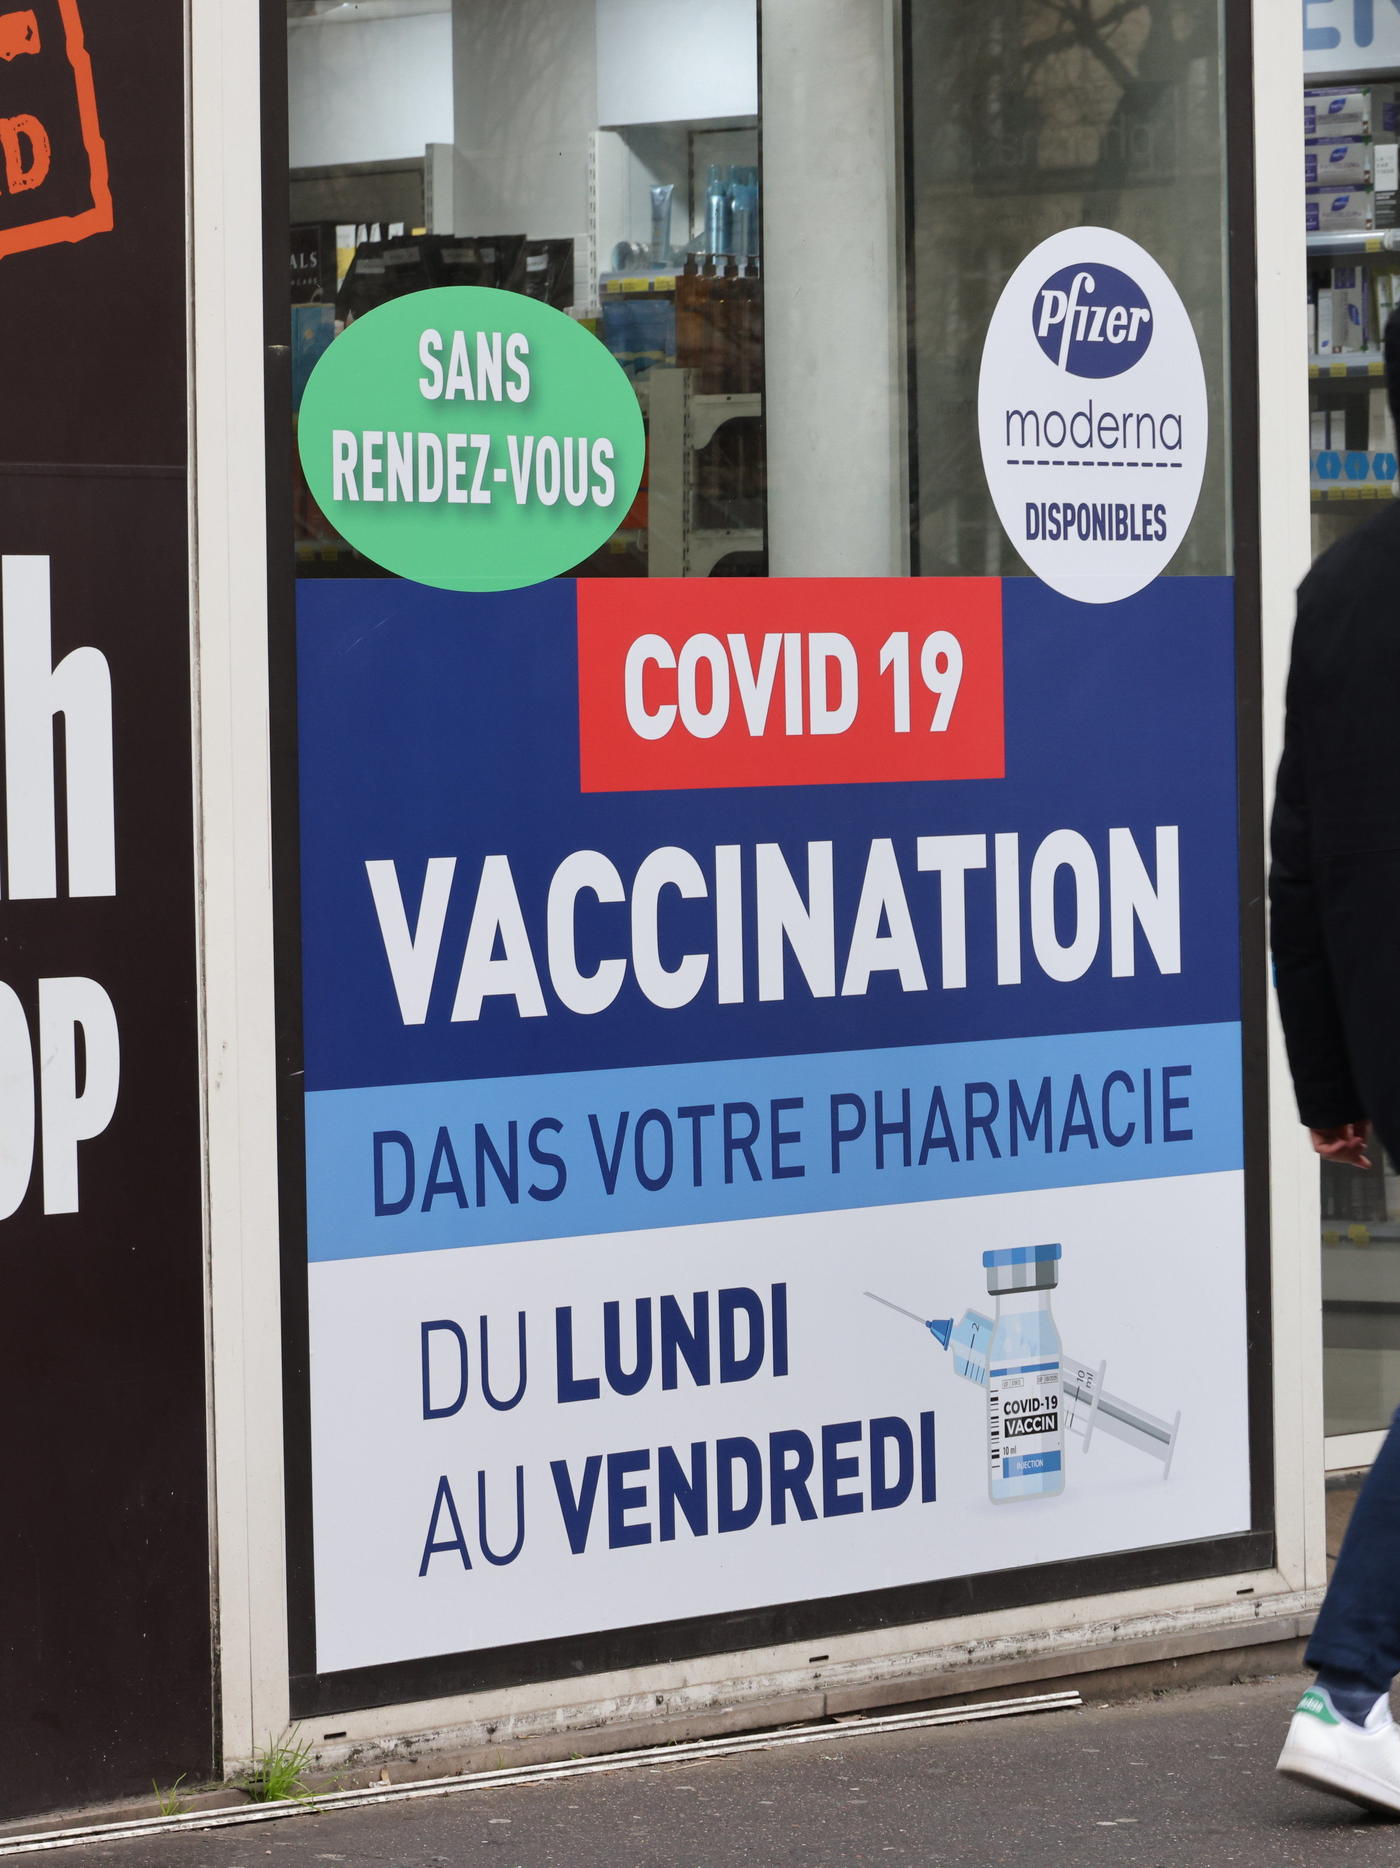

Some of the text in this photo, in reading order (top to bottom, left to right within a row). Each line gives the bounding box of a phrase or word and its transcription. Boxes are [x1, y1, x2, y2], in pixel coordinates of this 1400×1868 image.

[1036, 270, 1151, 372] Pfizer
[419, 329, 529, 402] SANS
[1006, 399, 1181, 450] moderna
[333, 430, 614, 506] RENDEZ-VOUS
[1026, 503, 1166, 541] DISPONIBLES
[625, 631, 963, 740] COVID 19
[365, 826, 1181, 1025] VACCINATION
[373, 1065, 1193, 1216] DANS VOTRE PHARMACIE
[421, 1283, 788, 1420] DU LUNDI
[1003, 1395, 1058, 1416] COVID-19
[1006, 1414, 1055, 1436] VACCIN
[419, 1411, 937, 1577] AU VENDREDI
[1016, 1458, 1044, 1471] INJECTION
